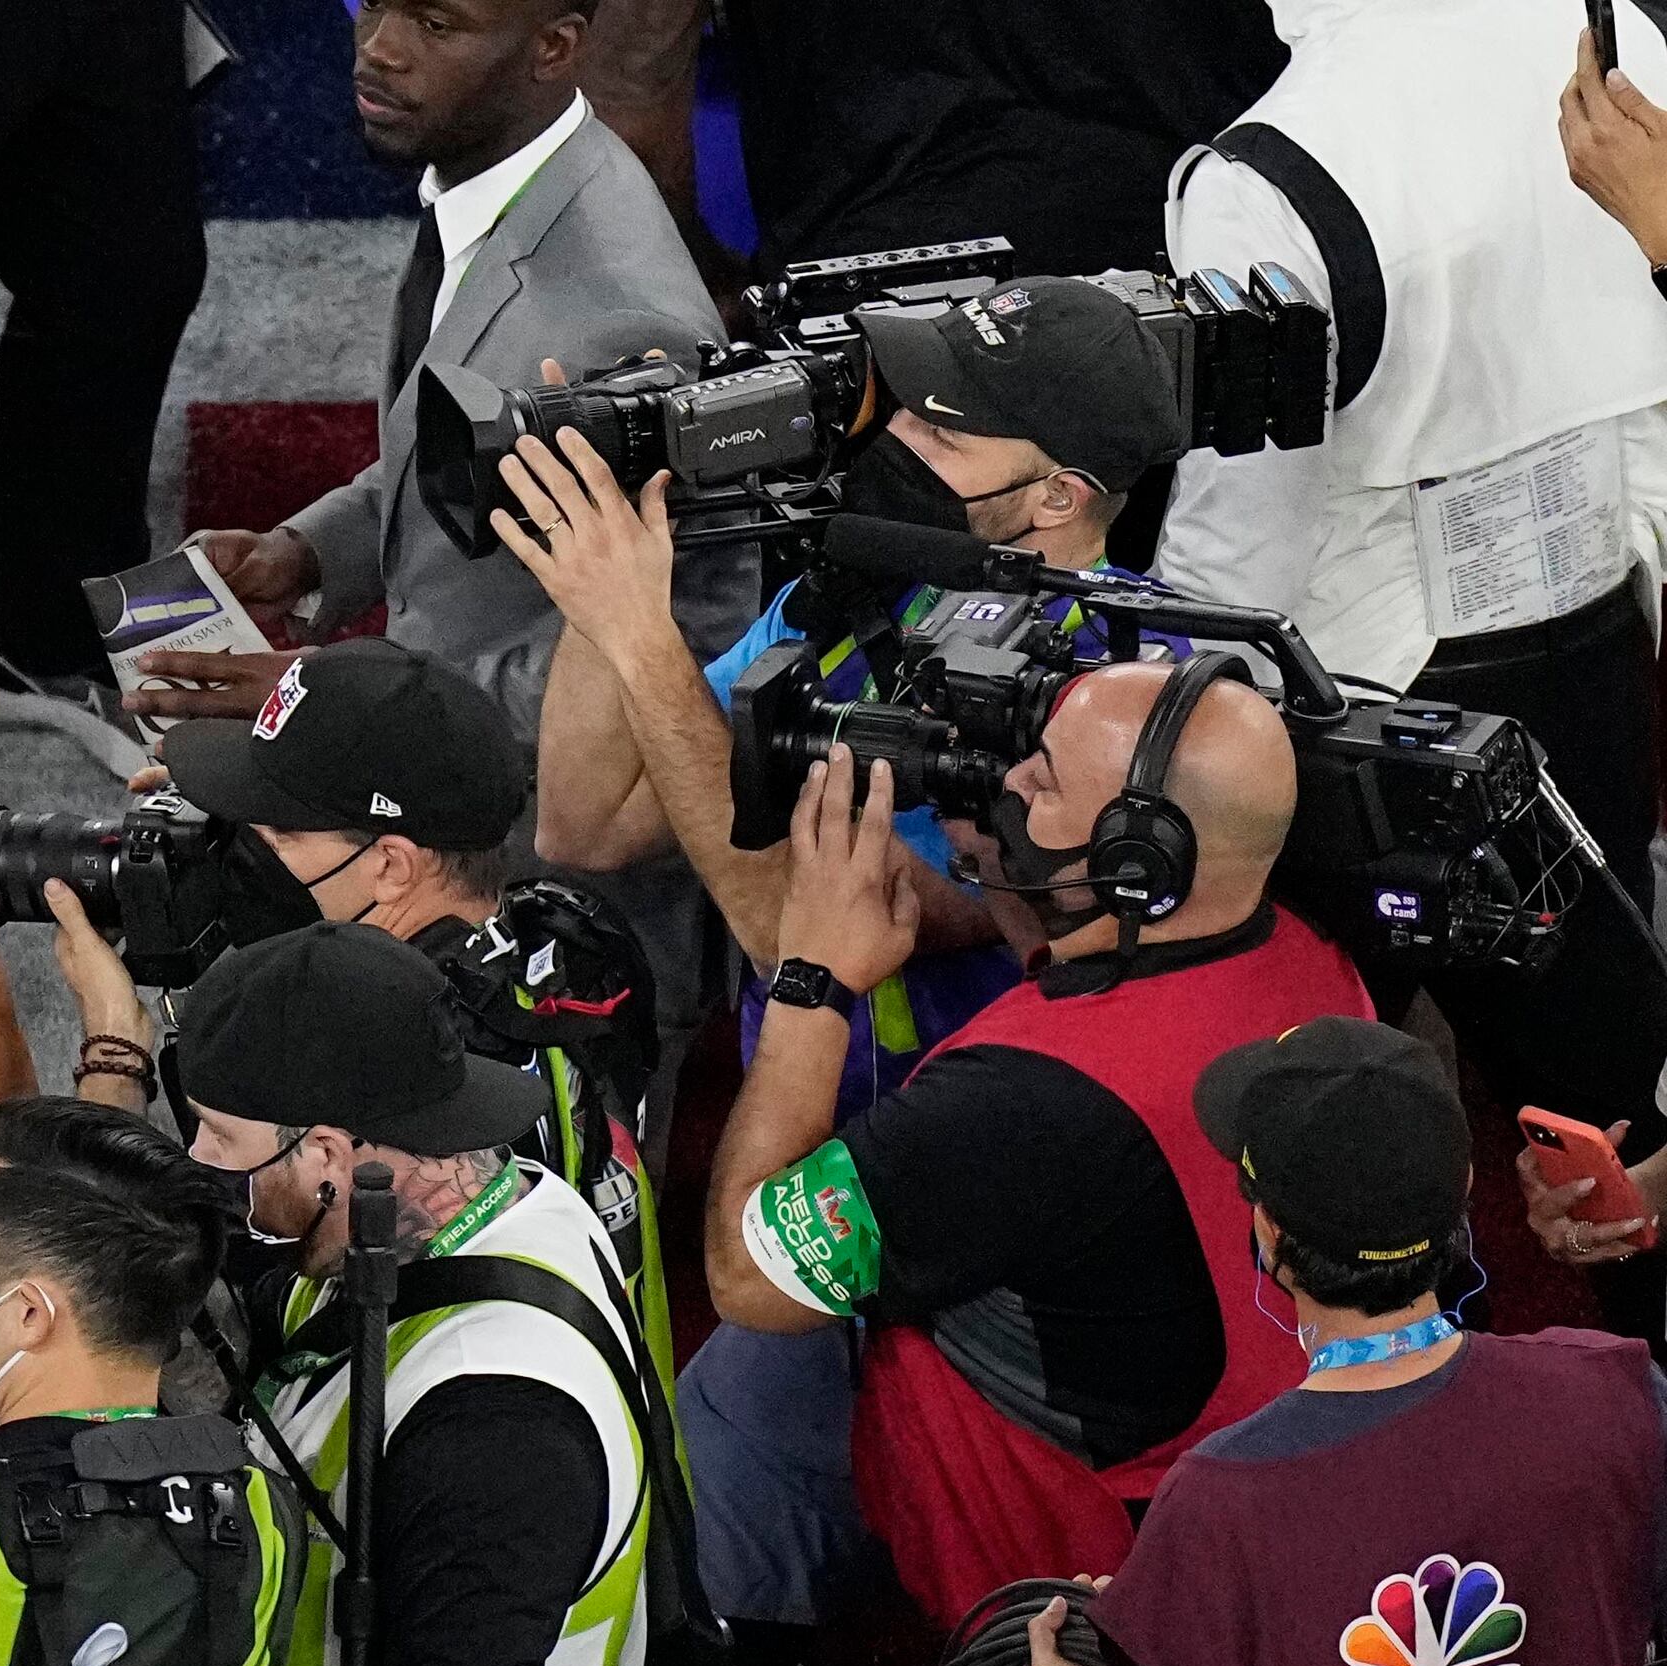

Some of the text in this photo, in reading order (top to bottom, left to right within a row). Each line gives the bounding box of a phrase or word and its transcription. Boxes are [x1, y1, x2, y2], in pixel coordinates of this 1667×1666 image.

[708, 427, 767, 451] AMIRA
[1393, 907, 1418, 919] cam9
[441, 1212, 476, 1249] FIELD
[475, 1175, 513, 1219] ACCESS
[773, 1184, 851, 1302] ACCESS
[789, 1171, 833, 1262] FIELD
